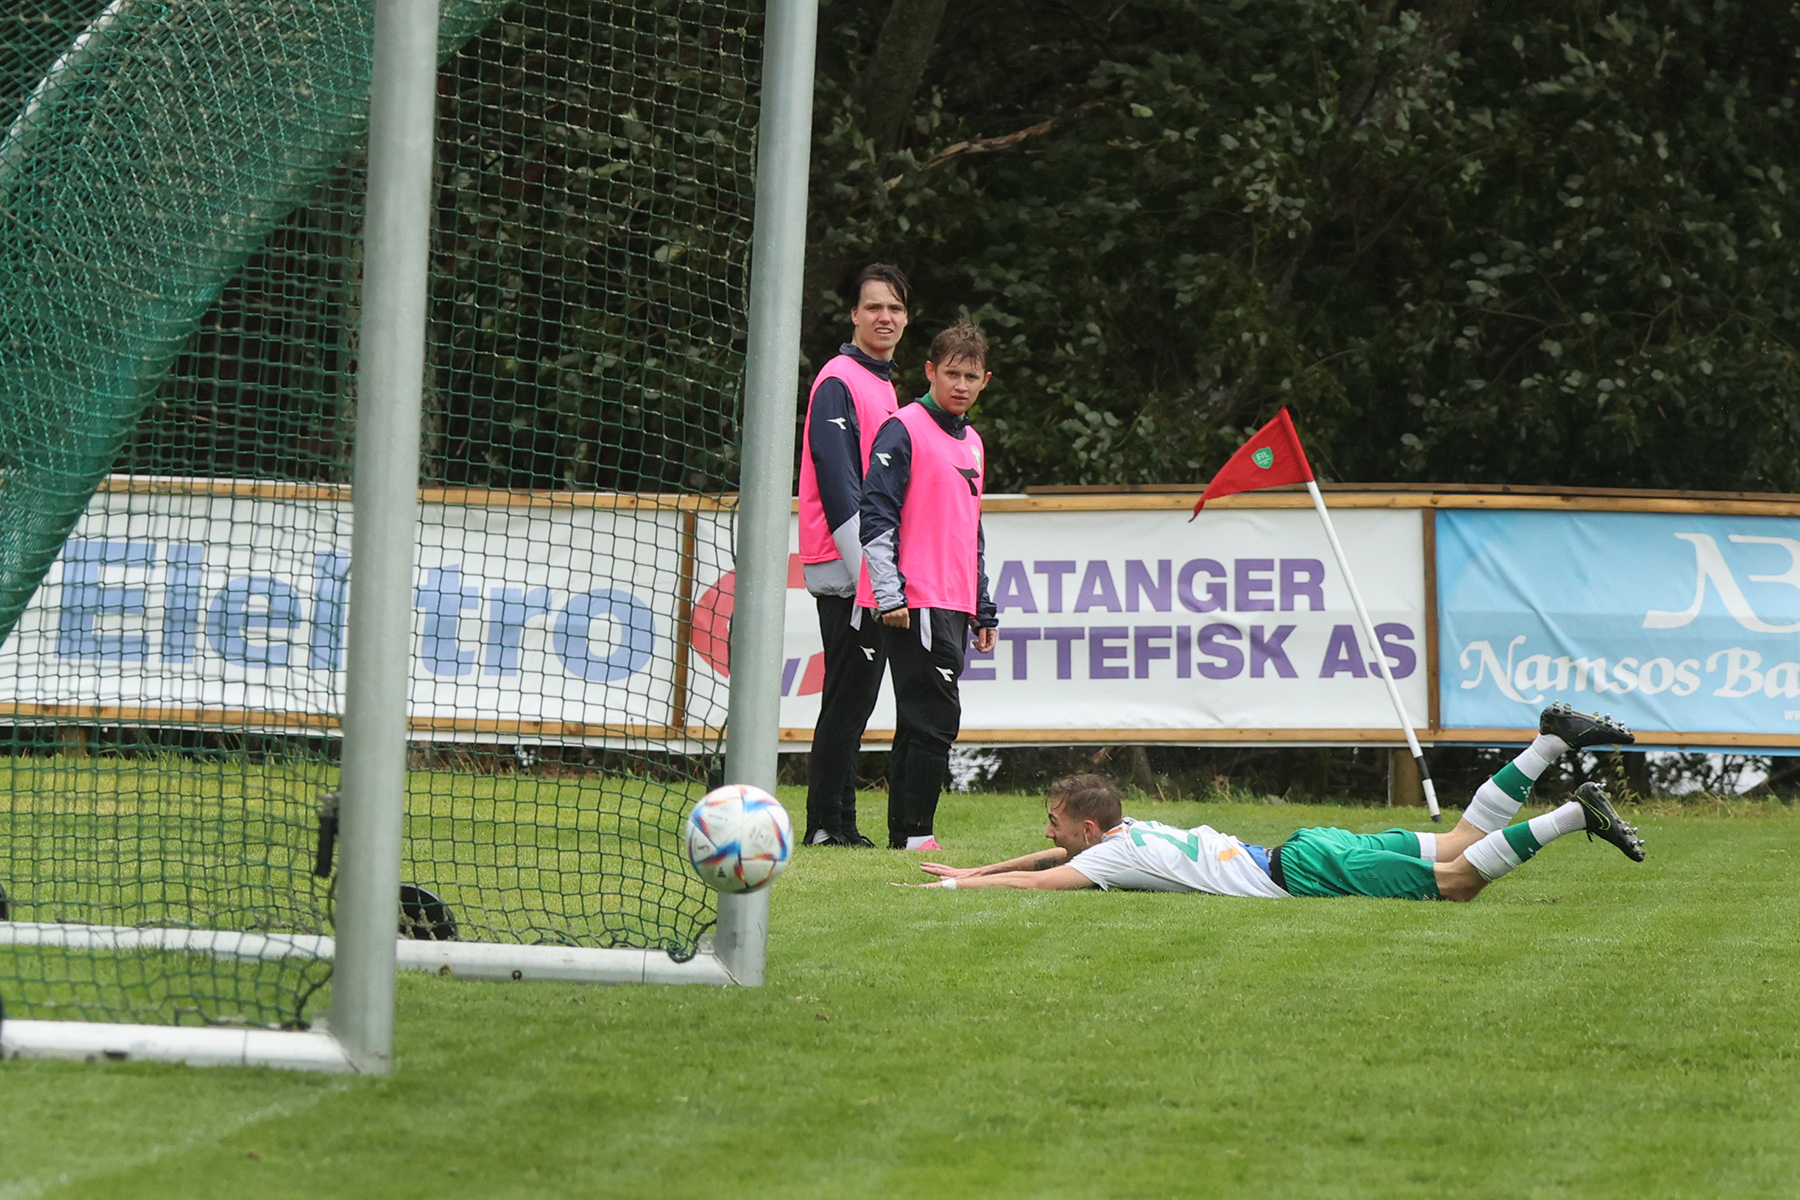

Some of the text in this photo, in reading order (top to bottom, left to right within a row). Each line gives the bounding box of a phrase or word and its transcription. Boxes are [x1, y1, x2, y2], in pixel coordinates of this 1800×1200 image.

[1256, 451, 1270, 461] FIL
[1318, 622, 1417, 680] AS
[1459, 635, 1800, 705] Namsos Ba
[1130, 821, 1198, 862] 2
